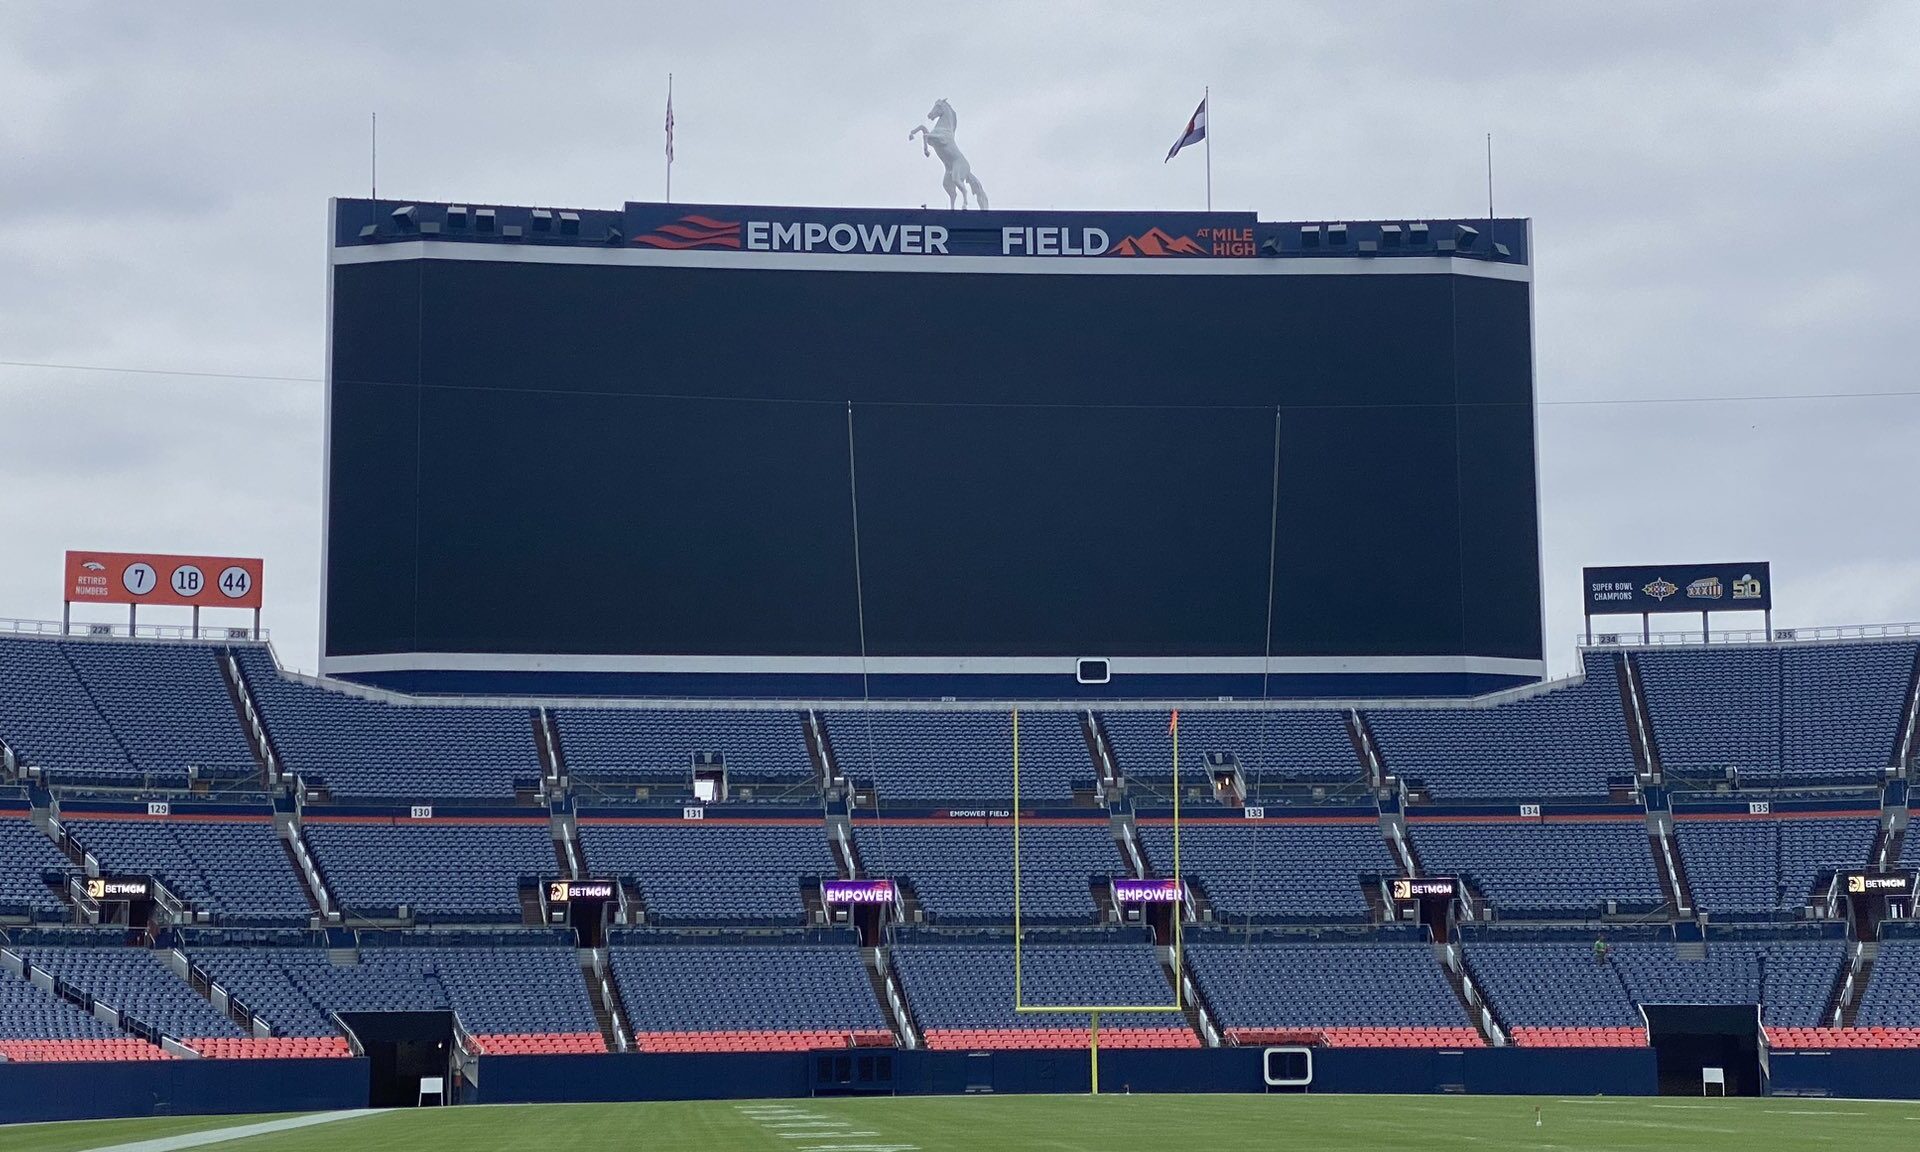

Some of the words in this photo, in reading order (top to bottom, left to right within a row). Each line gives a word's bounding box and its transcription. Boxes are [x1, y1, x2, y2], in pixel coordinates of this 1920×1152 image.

[747, 221, 949, 254] EMPOWER
[1002, 226, 1110, 255] FIELD
[1196, 229, 1209, 237] AT
[1212, 229, 1253, 241] MILE
[1212, 242, 1256, 256] HIGH
[77, 576, 107, 586] RETIRED
[134, 569, 145, 588] 7
[178, 571, 198, 590] 18
[223, 573, 246, 592] 44
[75, 586, 108, 596] NUMBERS
[1592, 583, 1613, 592] SUPER
[1615, 582, 1633, 591] BOWL
[1594, 592, 1632, 601] CHAMPIONS
[92, 626, 109, 635] 229
[230, 630, 246, 638] 230
[1777, 631, 1792, 639] 235
[1600, 636, 1616, 644] 234
[150, 804, 167, 813] 129
[413, 808, 430, 817] 130
[1247, 809, 1262, 817] 133
[1522, 806, 1538, 815] 134
[1752, 804, 1768, 813] 135
[686, 809, 701, 818] 131
[826, 889, 893, 902] EMPOWER
[1117, 889, 1183, 901] EMPOWER
